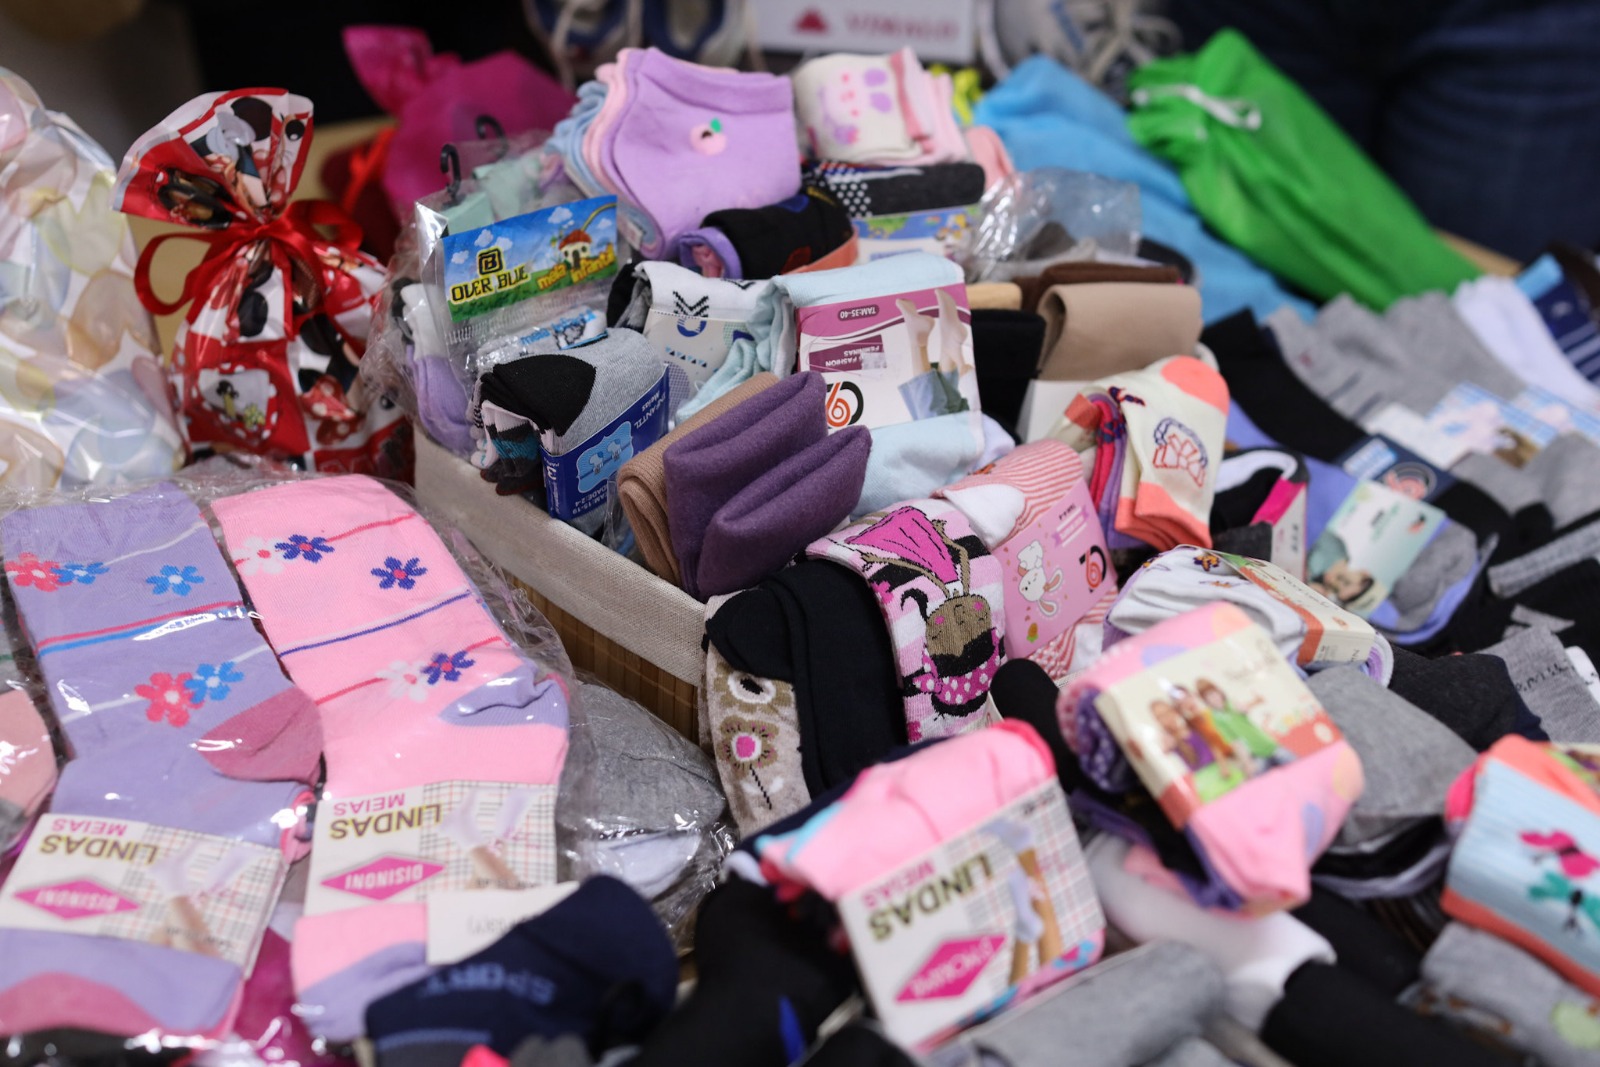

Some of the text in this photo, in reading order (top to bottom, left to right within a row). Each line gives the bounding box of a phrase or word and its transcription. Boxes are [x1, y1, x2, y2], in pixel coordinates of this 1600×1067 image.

[451, 264, 530, 302] OVER BLUE
[839, 306, 877, 319] TAM:35-40
[825, 355, 858, 368] FASHION
[333, 791, 406, 818] MEIAS
[51, 818, 129, 838] MEIAS
[328, 803, 444, 841] LINDAS
[38, 833, 159, 865] LINDAS
[342, 862, 426, 894] DISINONI
[869, 855, 993, 941] LINDAS
